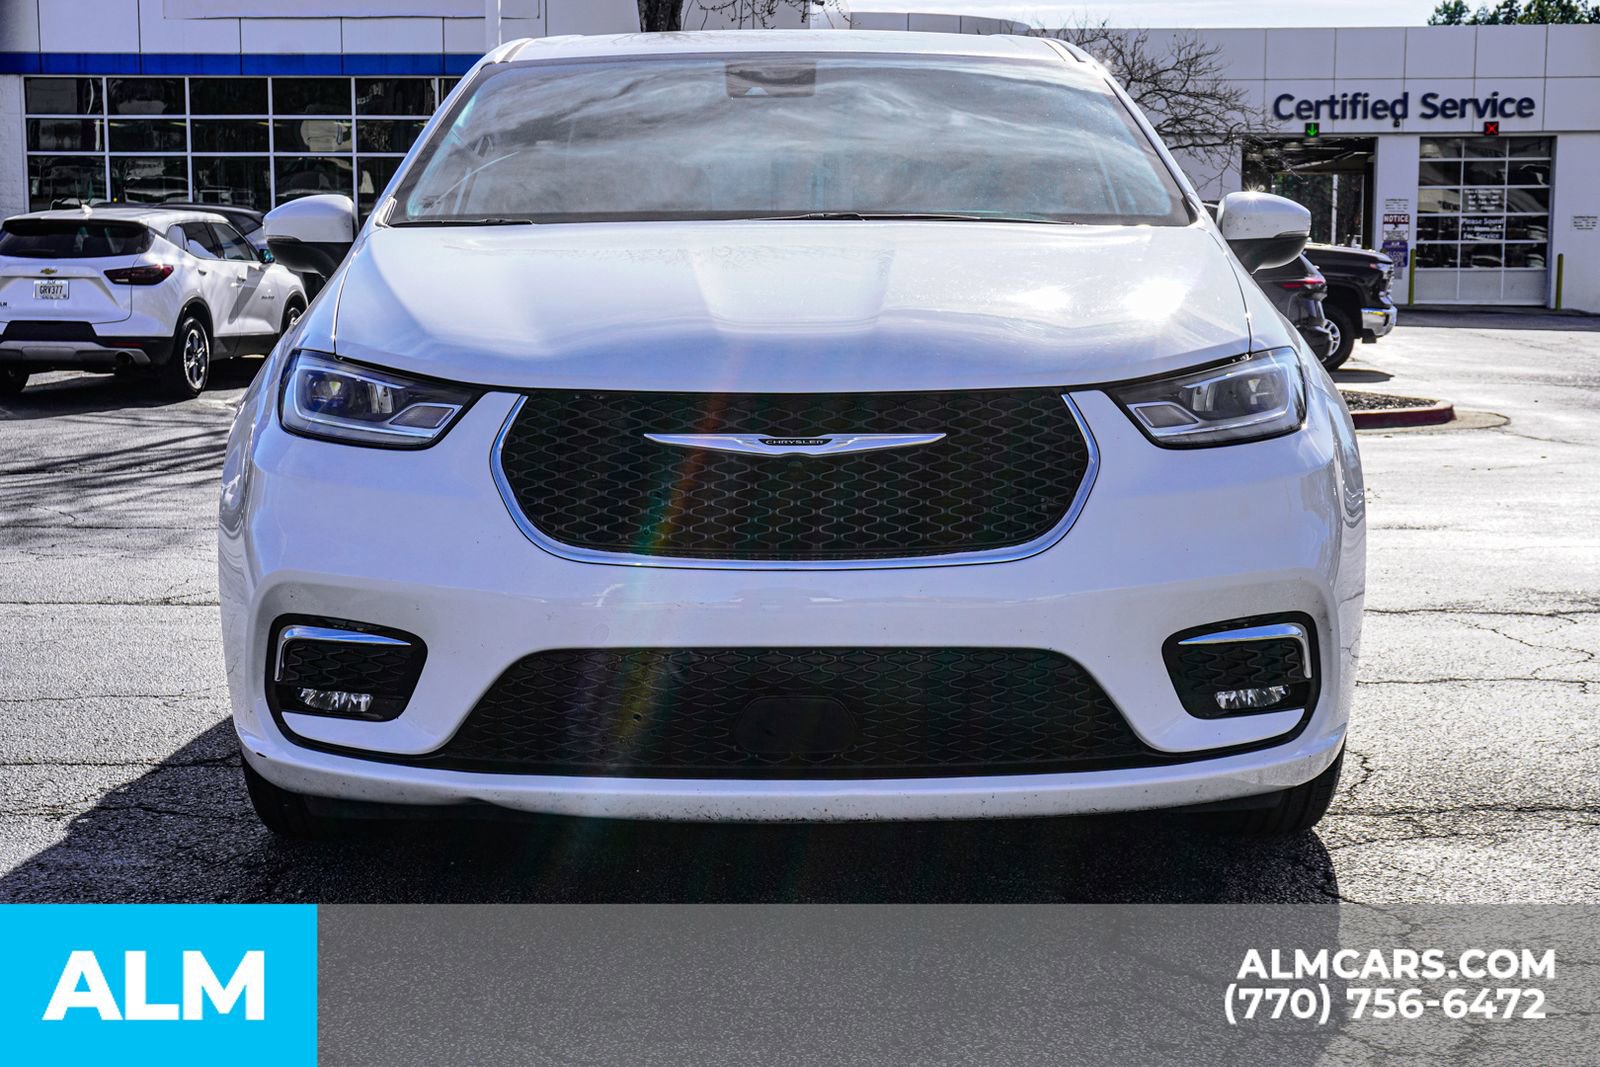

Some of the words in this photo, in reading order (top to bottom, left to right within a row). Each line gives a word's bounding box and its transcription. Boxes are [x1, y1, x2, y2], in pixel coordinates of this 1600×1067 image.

[1273, 92, 1409, 121] Certified
[1419, 91, 1536, 119] Service
[1384, 215, 1409, 223] NOTICE
